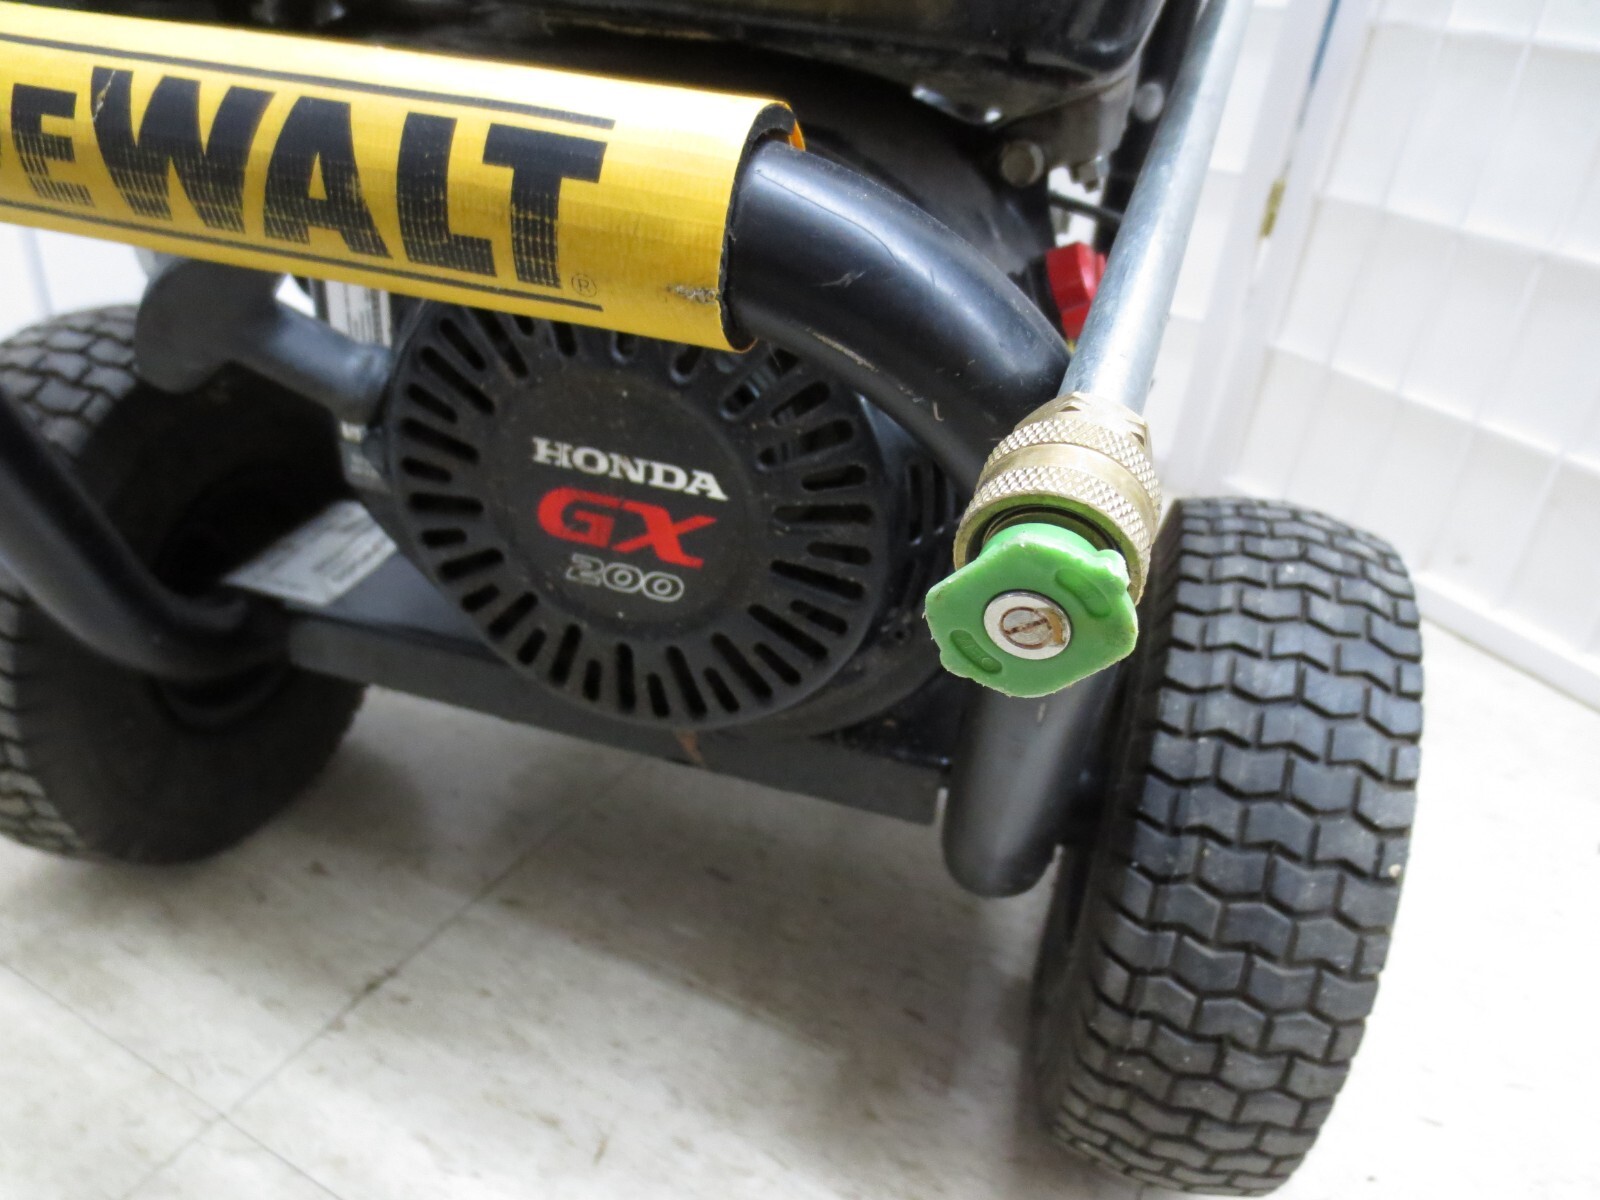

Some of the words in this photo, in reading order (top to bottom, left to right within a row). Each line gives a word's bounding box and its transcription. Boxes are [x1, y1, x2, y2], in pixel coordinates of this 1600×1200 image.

[0, 66, 608, 289] EWALT
[532, 436, 729, 501] HONDA
[537, 486, 717, 568] GX
[565, 552, 685, 602] 200
